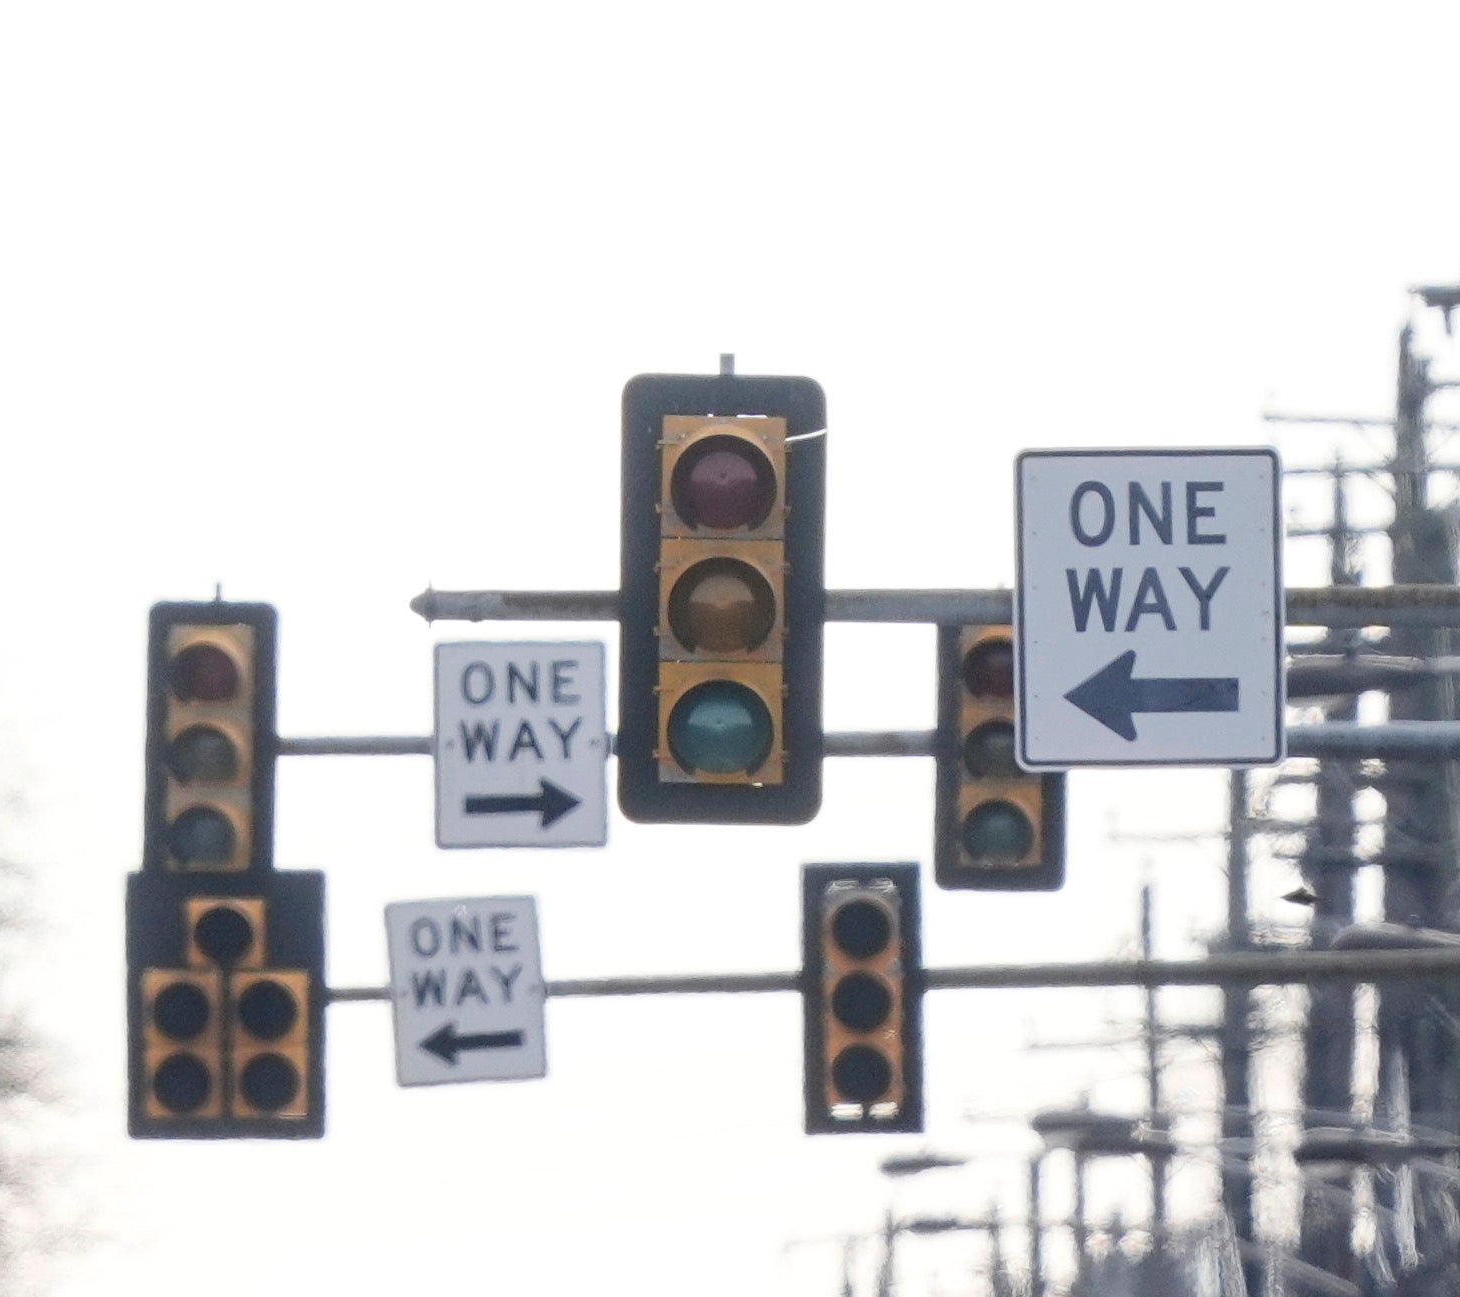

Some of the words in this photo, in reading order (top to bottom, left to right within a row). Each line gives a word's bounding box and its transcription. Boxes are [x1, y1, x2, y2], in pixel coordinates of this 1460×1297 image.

[1070, 480, 1226, 547] ONE
[1065, 566, 1230, 632] WAY
[460, 660, 581, 705] ONE
[459, 716, 583, 762] WAY
[409, 913, 520, 958] ONE
[410, 961, 523, 1009] WAY
